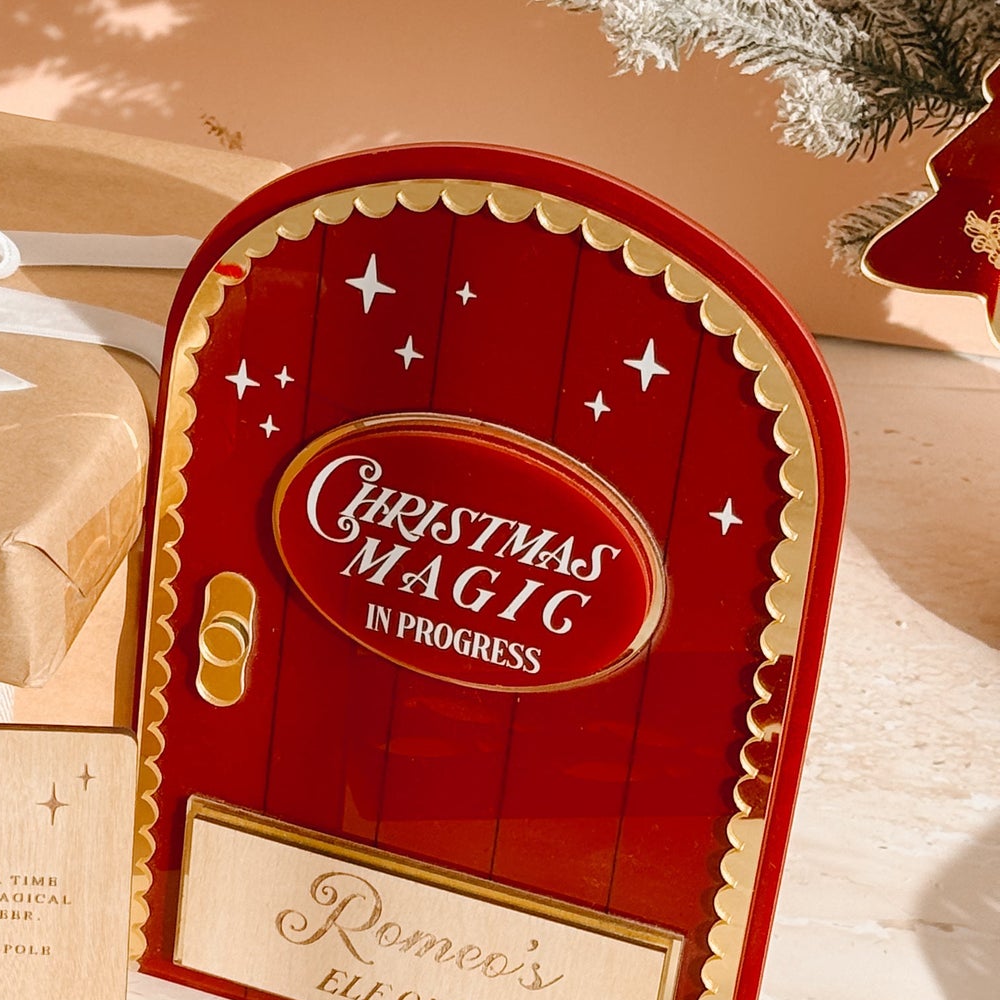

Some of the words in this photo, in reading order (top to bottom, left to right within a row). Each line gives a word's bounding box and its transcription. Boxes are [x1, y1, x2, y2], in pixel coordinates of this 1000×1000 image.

[306, 455, 621, 581] CHRISTMAS
[340, 536, 591, 634] MAGIC
[365, 603, 392, 634] IN
[396, 611, 542, 674] PROGRESS
[9, 875, 58, 887] TIME
[3, 944, 51, 956] POLE
[275, 871, 565, 990] Romeo's
